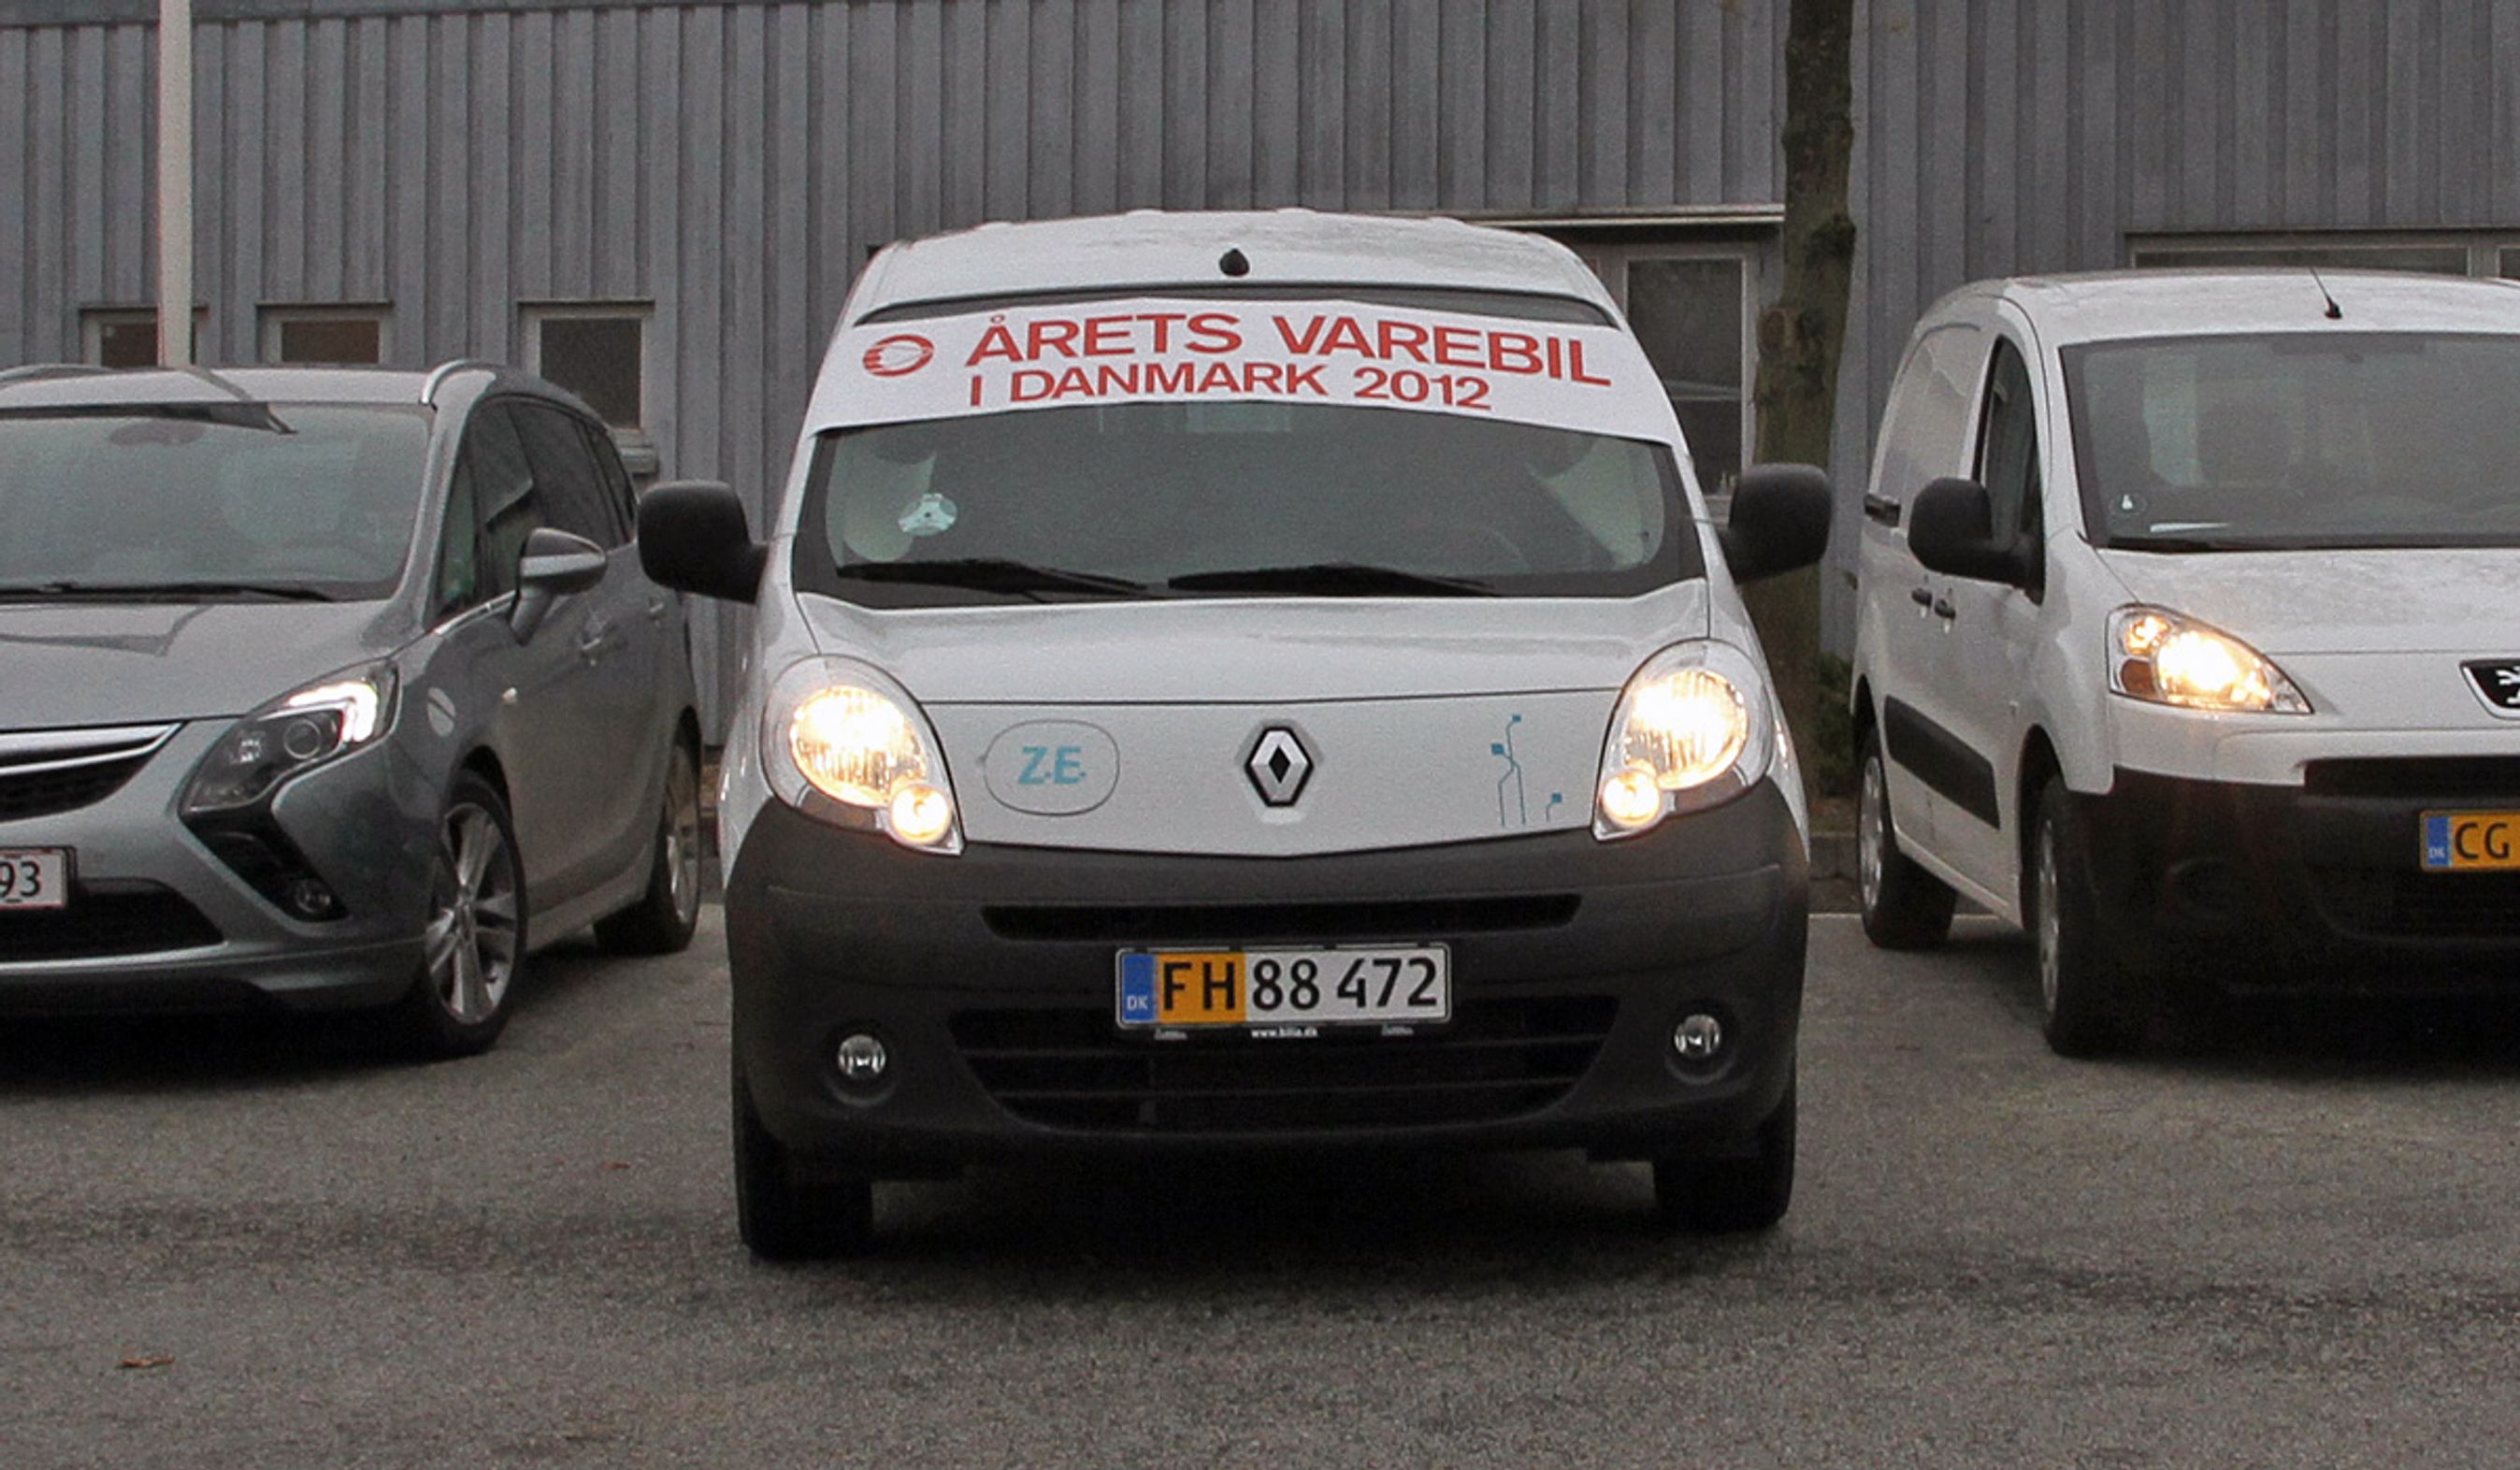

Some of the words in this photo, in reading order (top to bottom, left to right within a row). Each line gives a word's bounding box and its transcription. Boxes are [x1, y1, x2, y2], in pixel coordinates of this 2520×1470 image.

[965, 313, 1243, 367] ÅRETS
[1272, 315, 1612, 386] VAREBIL
[971, 374, 982, 407] I
[1010, 362, 1330, 402] DANMARK
[1354, 367, 1491, 411] 2012
[2455, 822, 2510, 859] CG
[1127, 996, 1148, 1010] DK
[1162, 961, 1236, 1011] FH
[1252, 958, 1320, 1011] 88
[1336, 957, 1438, 1009] 472
